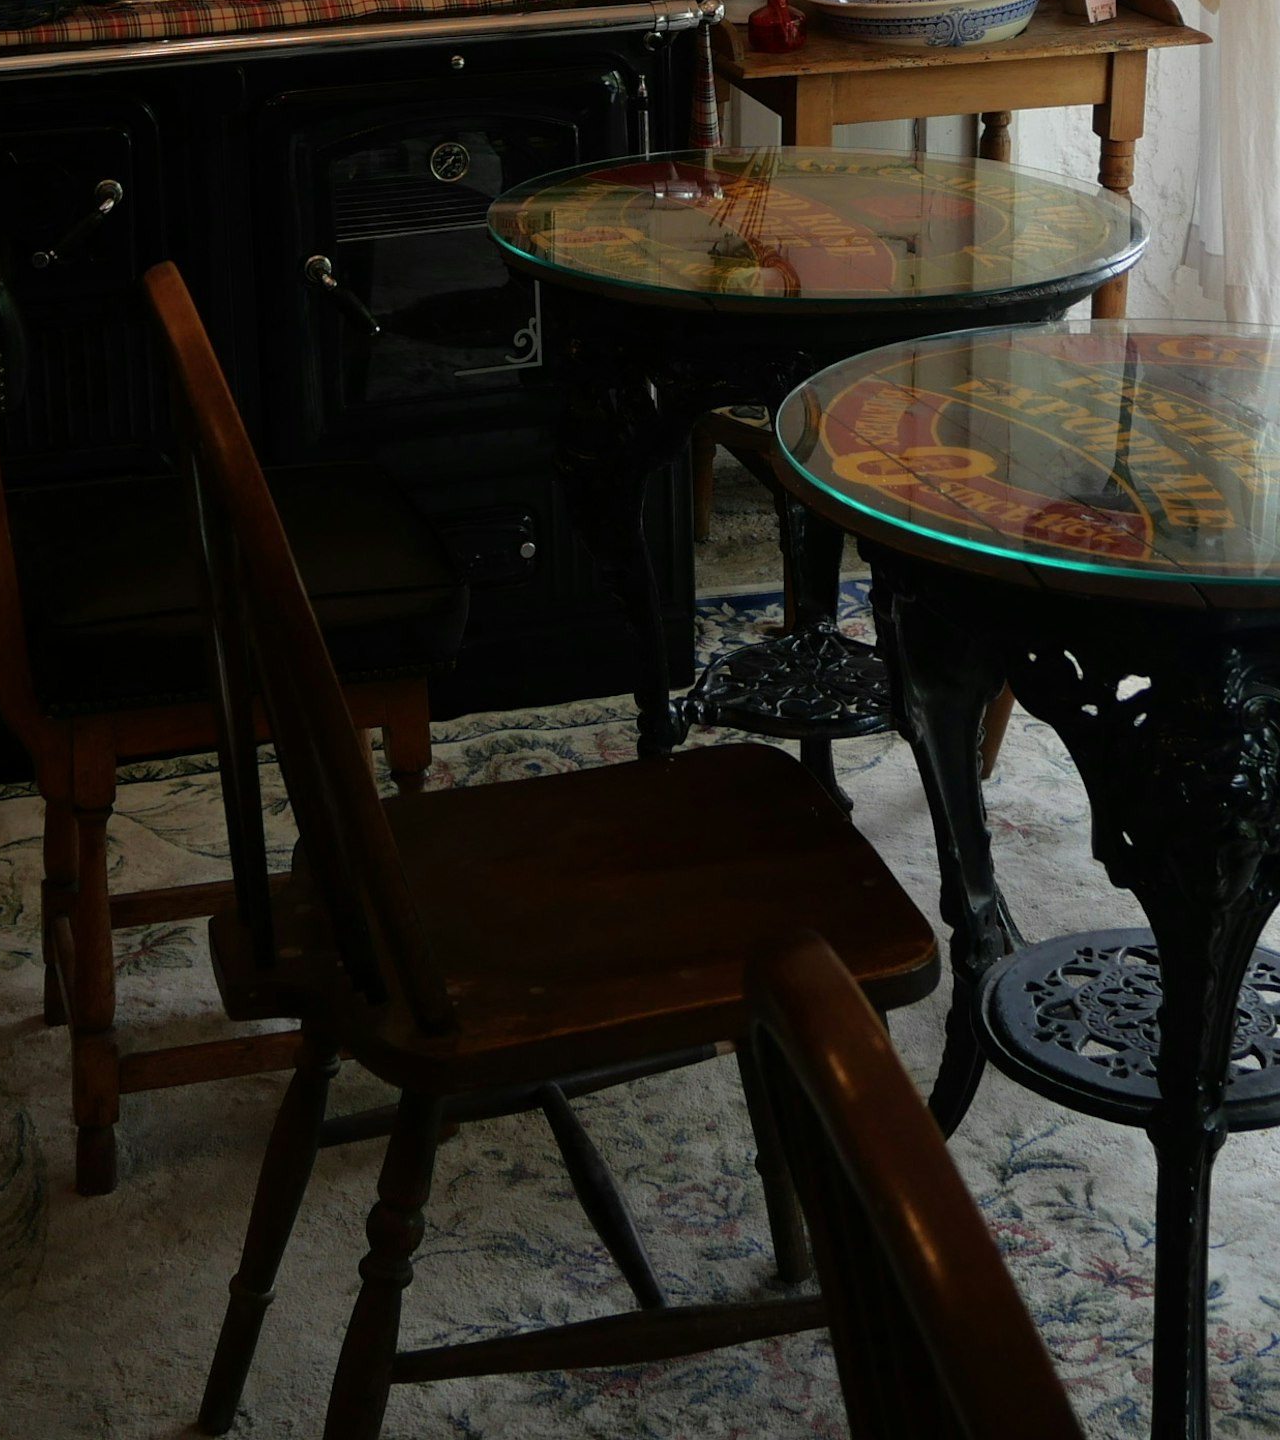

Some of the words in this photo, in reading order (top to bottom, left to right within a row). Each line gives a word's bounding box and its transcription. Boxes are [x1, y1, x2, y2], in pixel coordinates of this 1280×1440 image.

[790, 212, 877, 256] ROSE
[951, 377, 1190, 467] EXPORT
[1133, 471, 1238, 530] ALE
